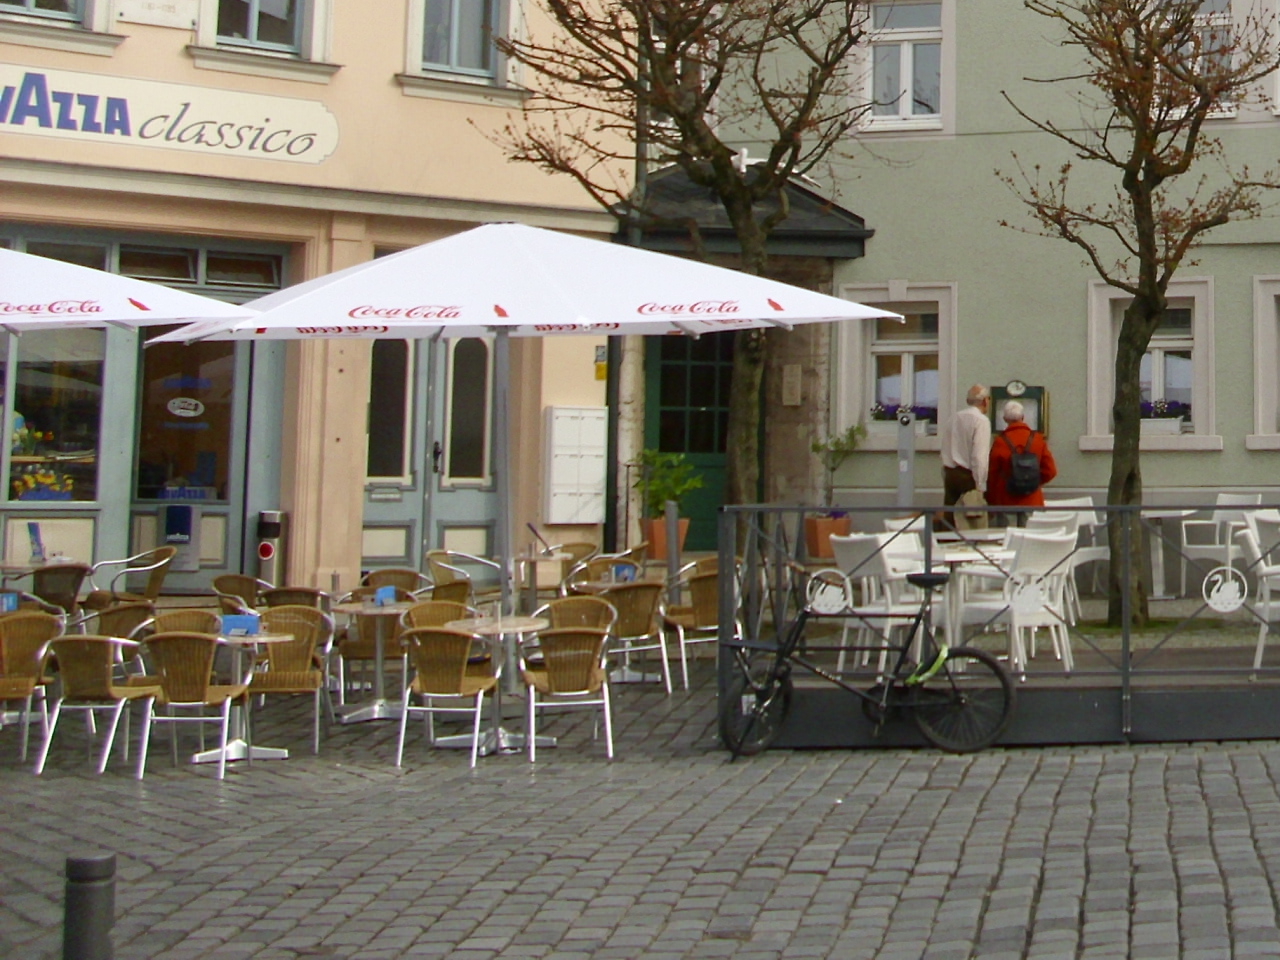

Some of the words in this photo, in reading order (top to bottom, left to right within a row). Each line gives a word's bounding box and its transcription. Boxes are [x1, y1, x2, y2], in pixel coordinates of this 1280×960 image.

[138, 101, 319, 156] classico
[347, 304, 464, 320] Coca-Cola
[636, 299, 741, 316] Coca-Cola
